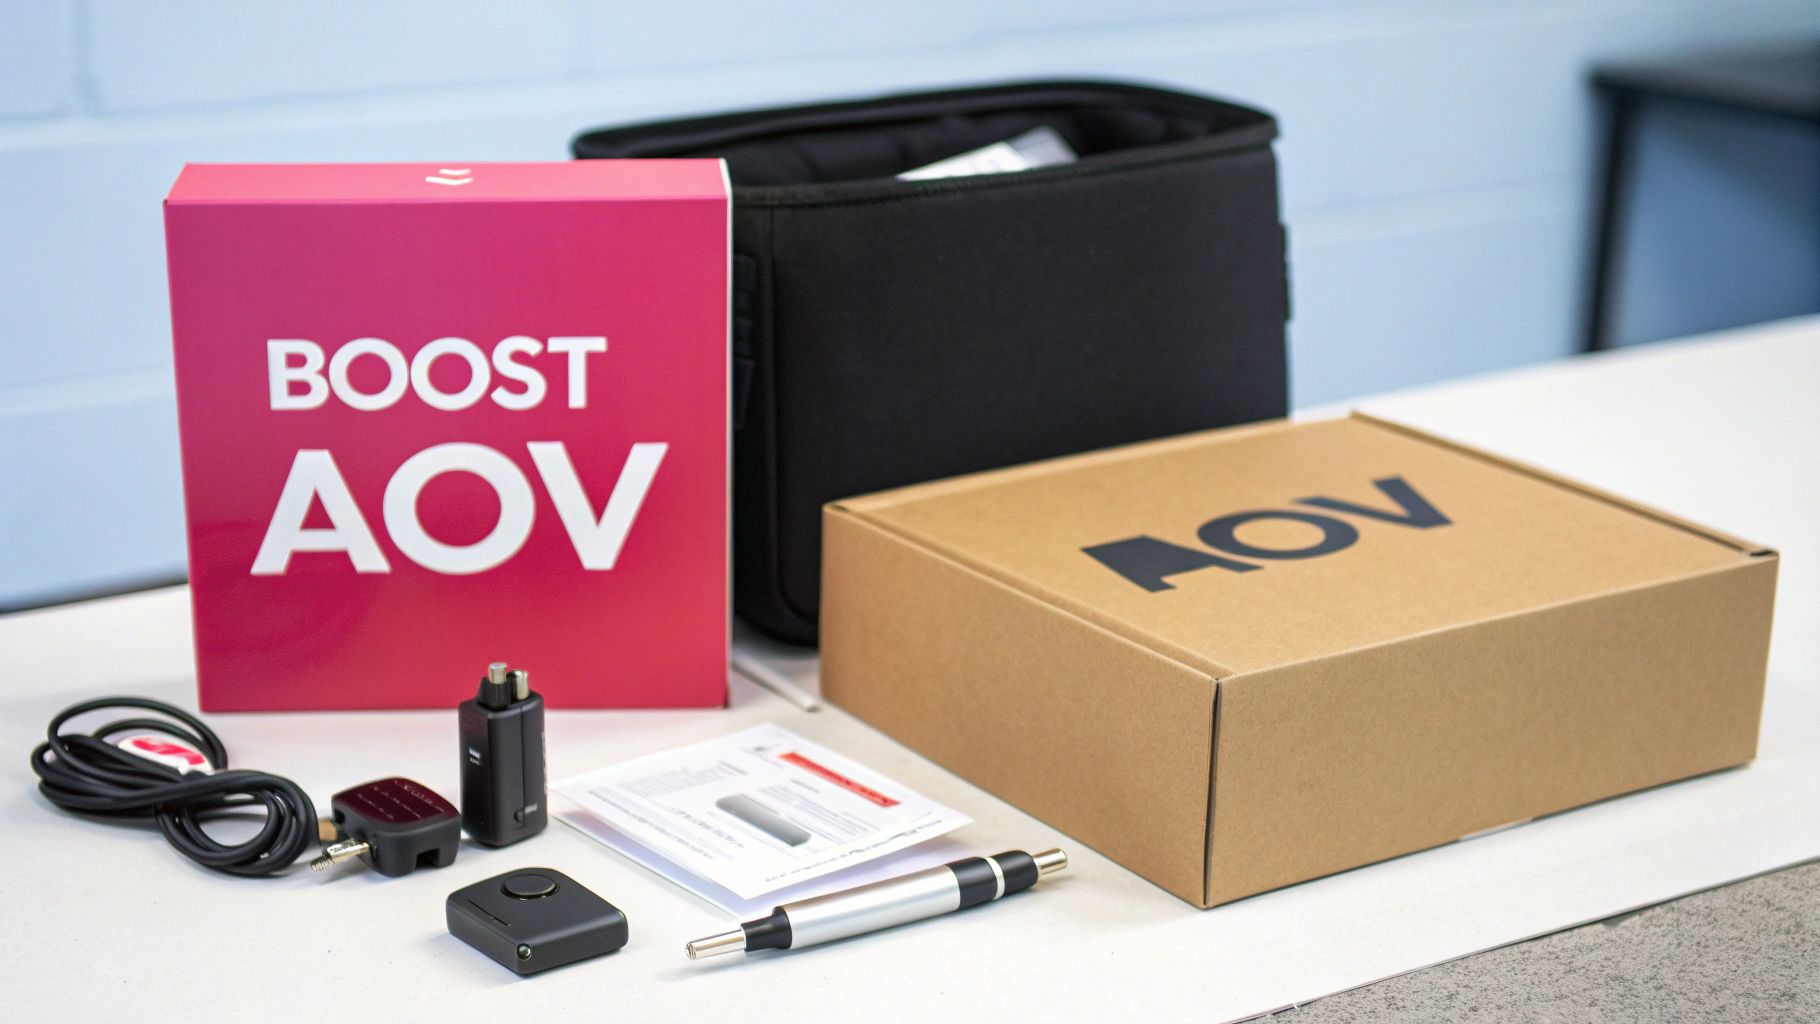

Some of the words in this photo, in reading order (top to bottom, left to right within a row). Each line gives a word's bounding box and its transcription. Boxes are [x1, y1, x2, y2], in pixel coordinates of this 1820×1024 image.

[266, 336, 607, 411] BOOST
[250, 441, 669, 575] AOV
[1080, 475, 1454, 593] AOV
